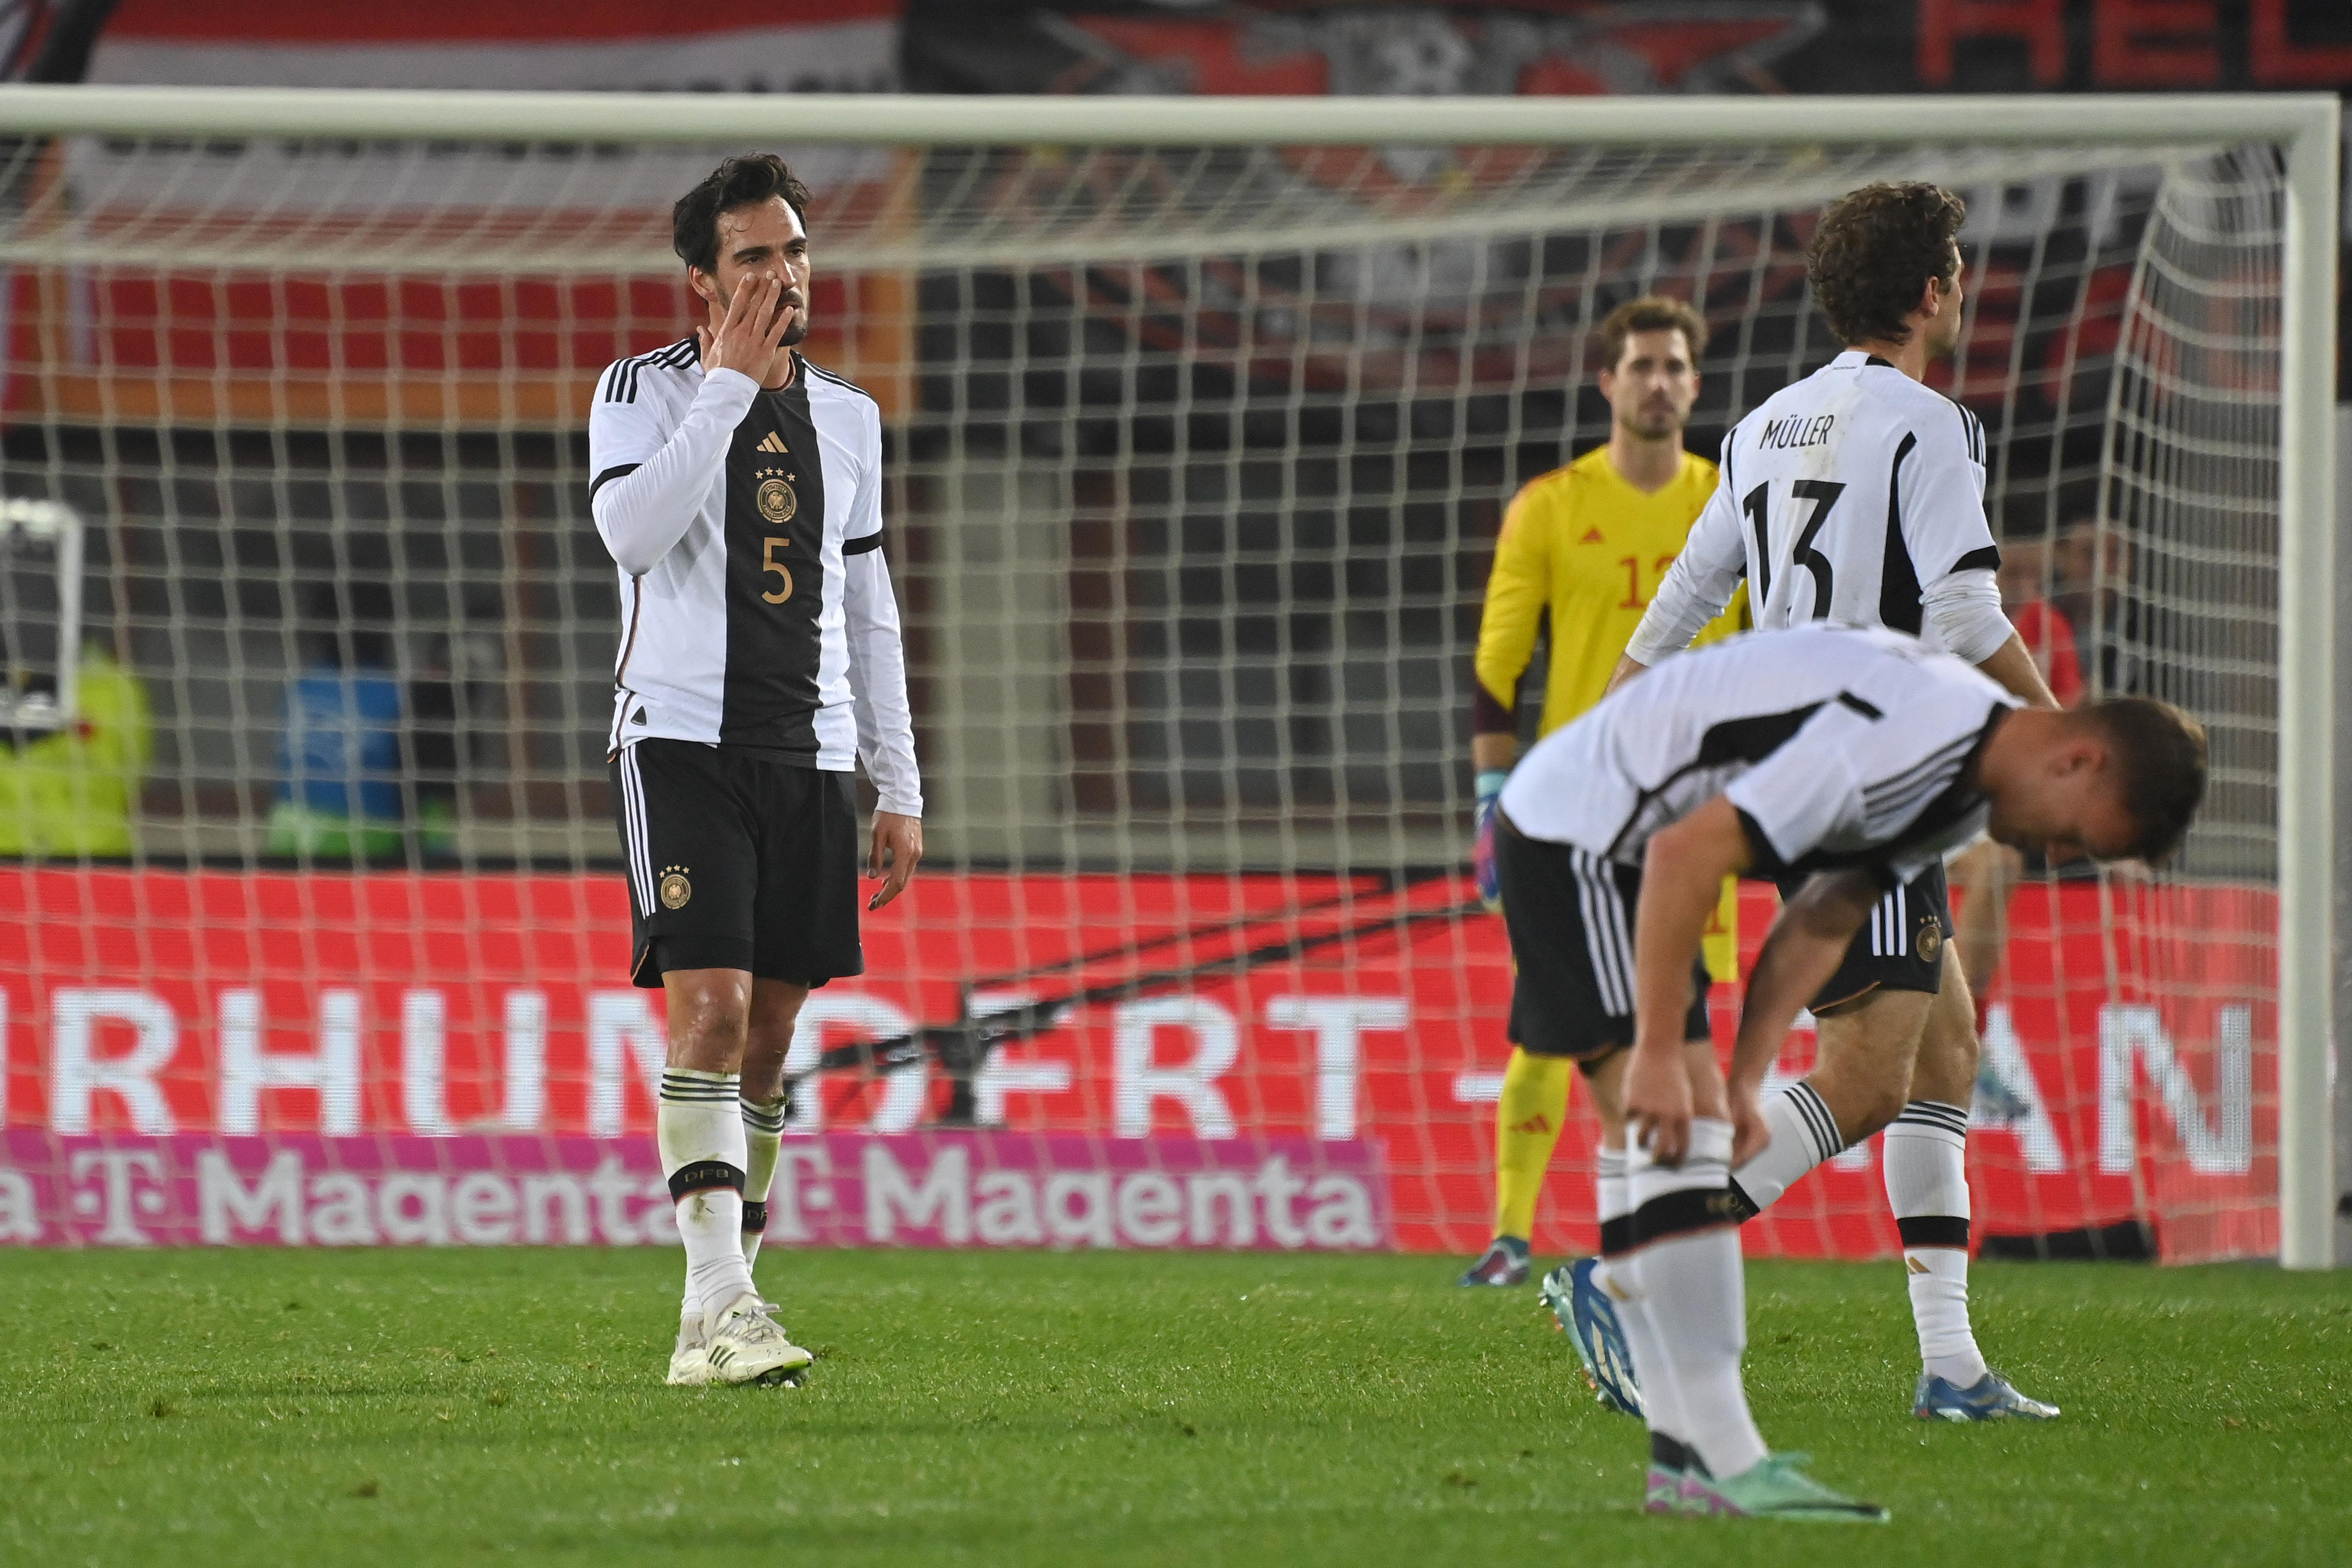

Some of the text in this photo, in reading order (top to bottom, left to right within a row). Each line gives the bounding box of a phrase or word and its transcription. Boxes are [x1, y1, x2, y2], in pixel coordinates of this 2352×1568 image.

[1759, 414, 1835, 449] MÜLLER
[762, 537, 793, 604] 5
[1743, 480, 1847, 626] 13
[0, 986, 1409, 1141] RHUNDERT
[864, 1143, 1381, 1247] Magenta
